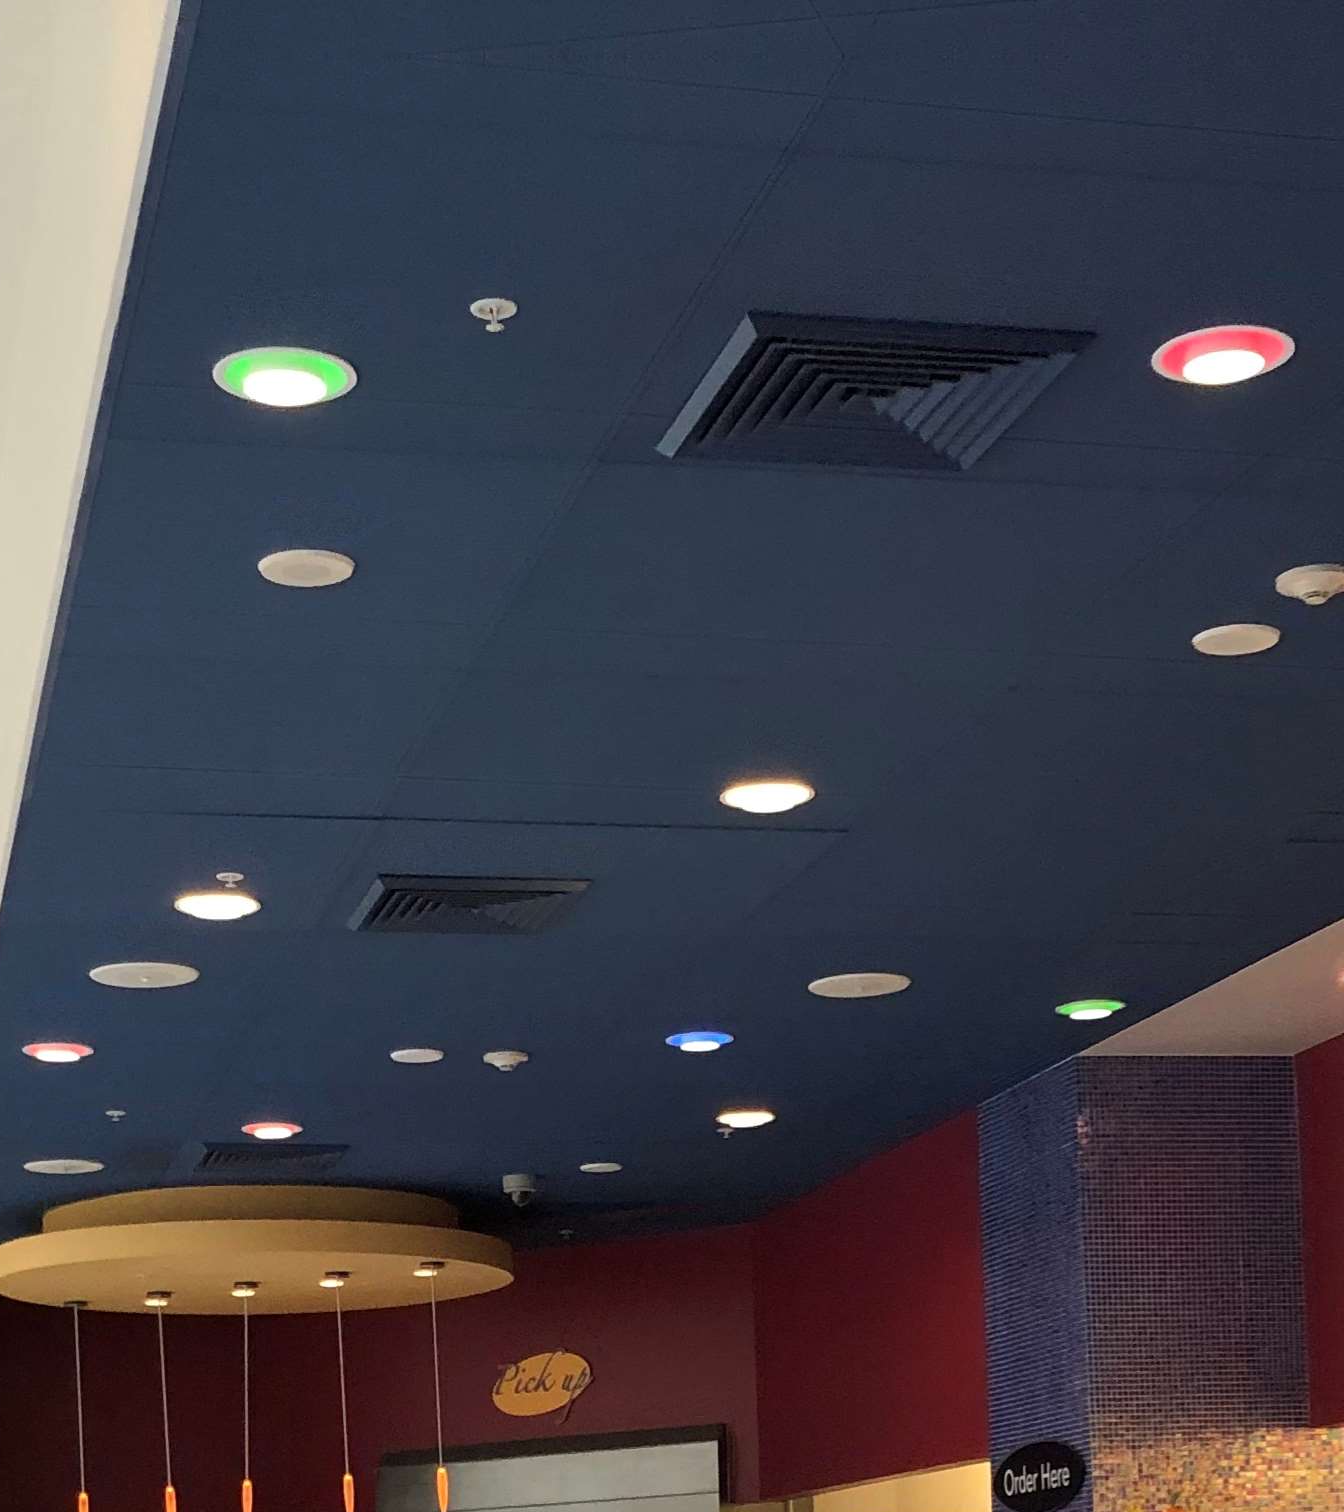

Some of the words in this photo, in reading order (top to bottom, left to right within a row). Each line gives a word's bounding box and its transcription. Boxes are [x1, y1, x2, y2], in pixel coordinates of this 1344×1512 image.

[494, 1348, 567, 1396] Pick
[560, 1367, 595, 1424] up
[1003, 1464, 1038, 1496] Order
[1040, 1461, 1070, 1490] Here
